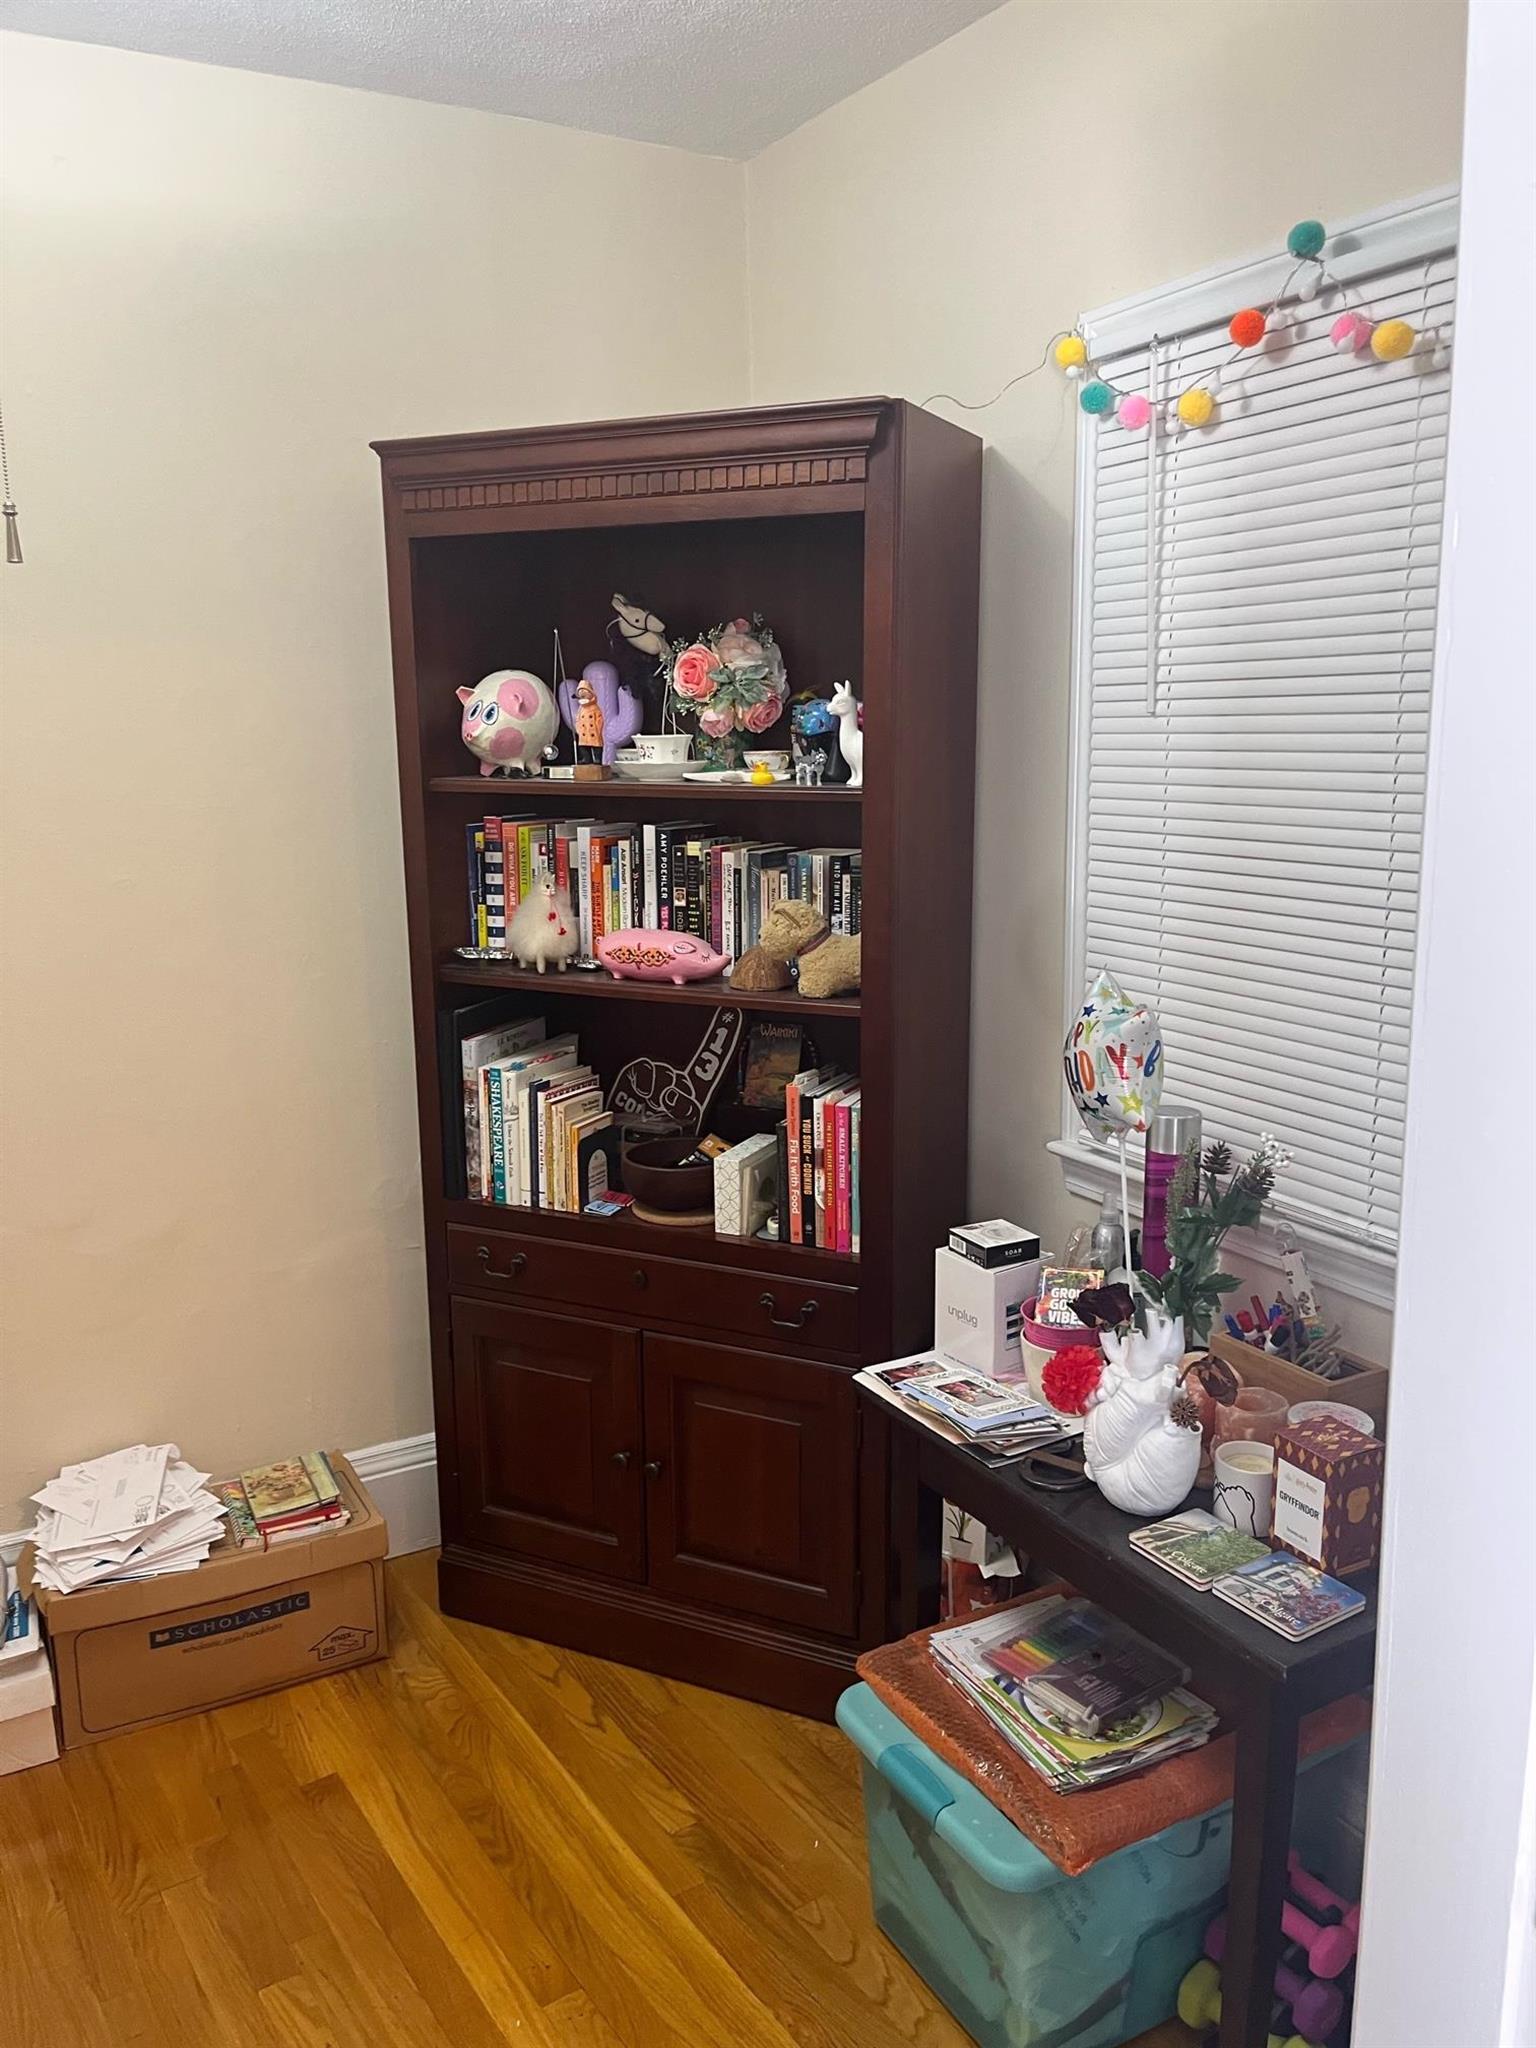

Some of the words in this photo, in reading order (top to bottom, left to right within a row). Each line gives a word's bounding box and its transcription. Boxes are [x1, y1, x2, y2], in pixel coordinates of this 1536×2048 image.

[660, 833, 668, 854] AMY
[660, 856, 669, 899] POEHLER
[491, 1080, 504, 1167] SHAKESPEARE
[802, 1119, 811, 1134] YOU
[790, 1140, 798, 1153] Fix
[803, 1135, 811, 1154] SUCK
[790, 1166, 799, 1187] with
[803, 1163, 812, 1195] COOKING
[791, 1189, 800, 1214] Food
[948, 1305, 978, 1328] unplug
[1279, 1490, 1320, 1520] GRYFFINDOR
[174, 1594, 308, 1640] SCHOLASTIC
